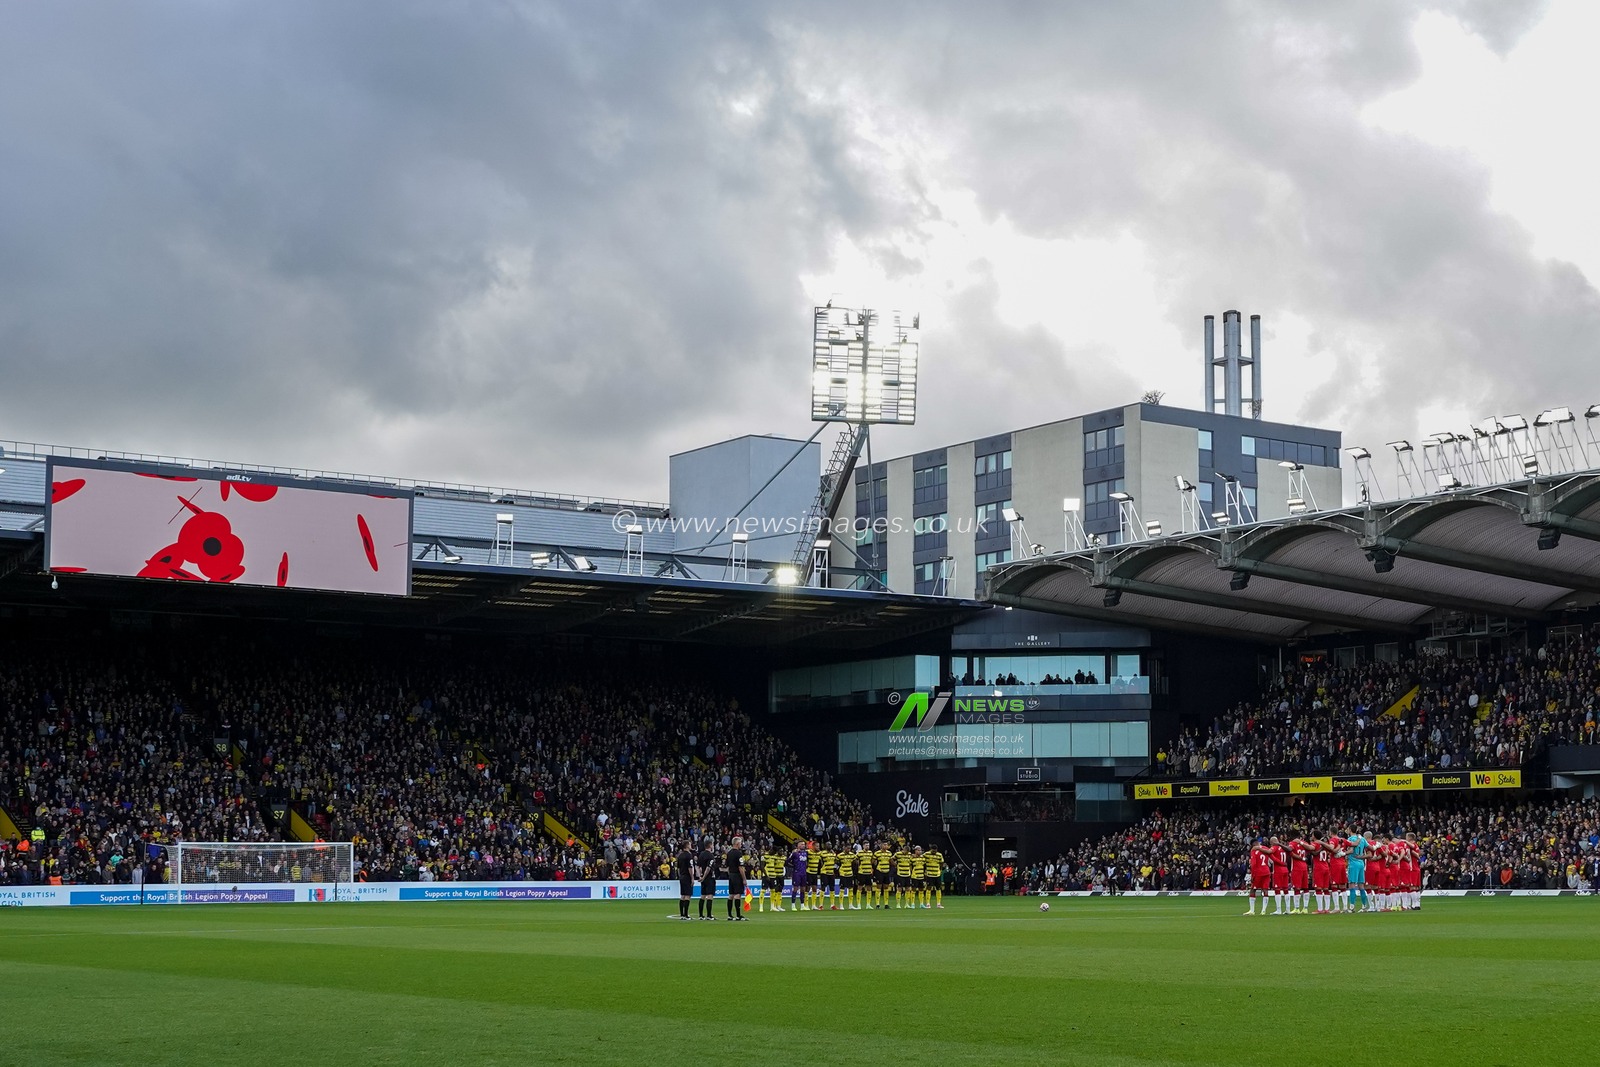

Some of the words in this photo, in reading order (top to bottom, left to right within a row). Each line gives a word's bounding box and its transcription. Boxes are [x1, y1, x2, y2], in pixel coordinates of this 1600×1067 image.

[226, 474, 252, 482] adi.tv
[1333, 779, 1375, 788] Empowerment
[1386, 778, 1412, 786] Respect
[1432, 776, 1461, 784] Inclusion
[1475, 774, 1491, 785] We
[1217, 784, 1241, 792] Together
[1257, 782, 1281, 791] Diversity
[1301, 781, 1320, 789] Family
[1156, 786, 1168, 796] We
[1180, 786, 1201, 794] Equality
[896, 789, 929, 818] Stake
[1260, 854, 1266, 866] 2
[100, 894, 130, 903] Support
[147, 893, 167, 902] Royal
[195, 893, 218, 902] Legion
[244, 892, 268, 901] Appeal
[424, 890, 450, 899] Support
[464, 890, 482, 898] Royal
[483, 889, 504, 897] British
[505, 889, 526, 898] Legion
[527, 889, 546, 897] Poppy
[547, 889, 569, 898] Appeal
